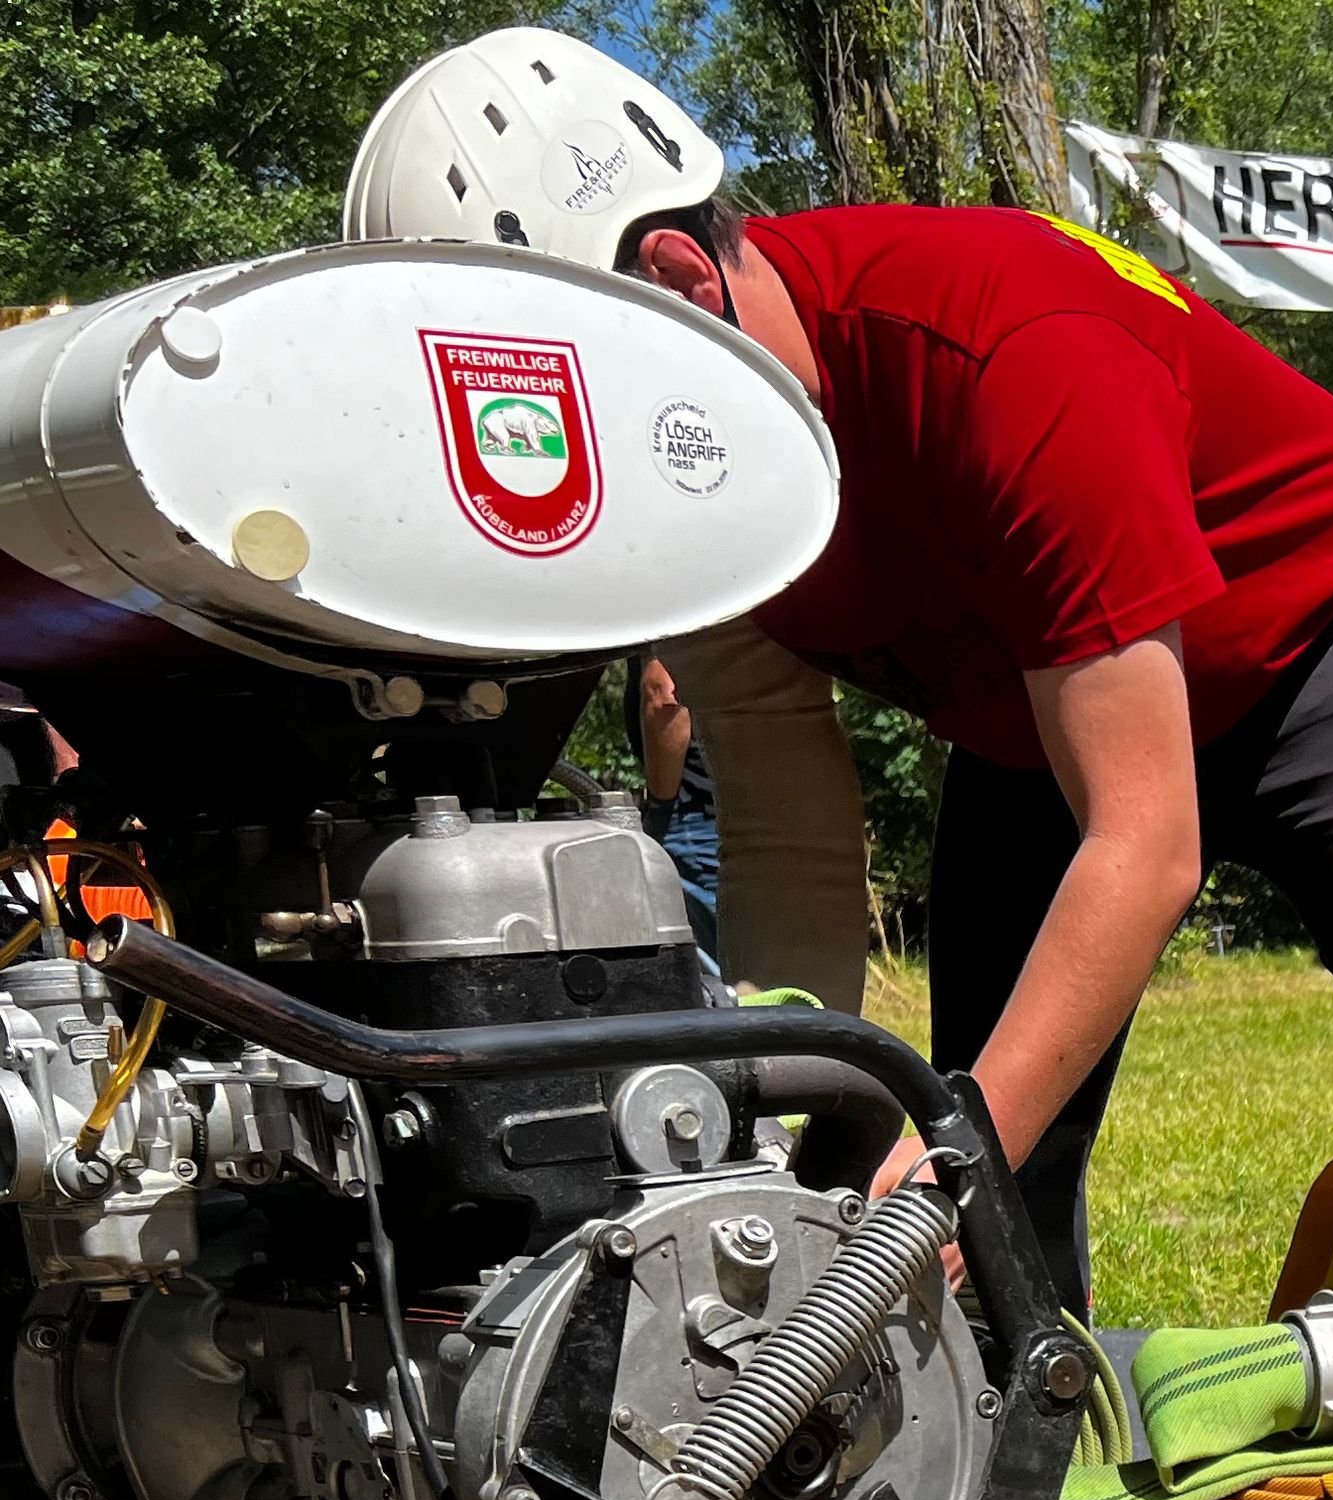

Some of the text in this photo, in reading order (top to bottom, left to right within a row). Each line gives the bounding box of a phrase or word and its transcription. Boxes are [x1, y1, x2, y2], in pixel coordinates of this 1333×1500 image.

[446, 348, 561, 373] FREIWILLIGE
[451, 371, 567, 394] FEUERWEHR
[665, 419, 712, 443] LÖSCH
[667, 440, 726, 462] ANGRIFF
[668, 457, 696, 470] nass
[557, 500, 587, 536] HARZ
